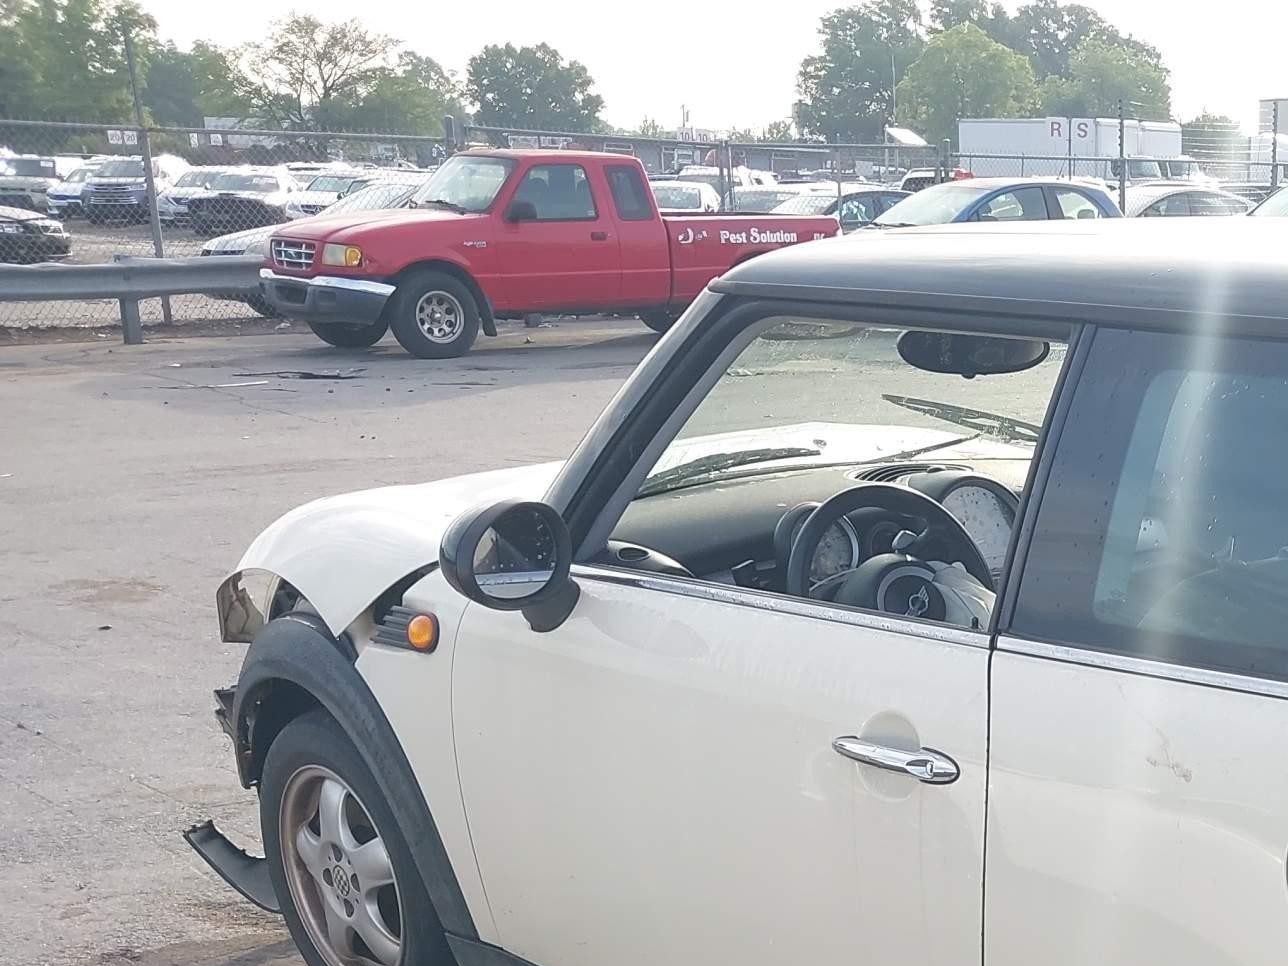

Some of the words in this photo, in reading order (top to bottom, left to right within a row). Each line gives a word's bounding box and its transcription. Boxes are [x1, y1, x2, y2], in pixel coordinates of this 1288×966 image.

[1050, 121, 1062, 137] R
[1077, 122, 1089, 138] S
[720, 230, 747, 244] Pest
[750, 227, 797, 243] Solution
